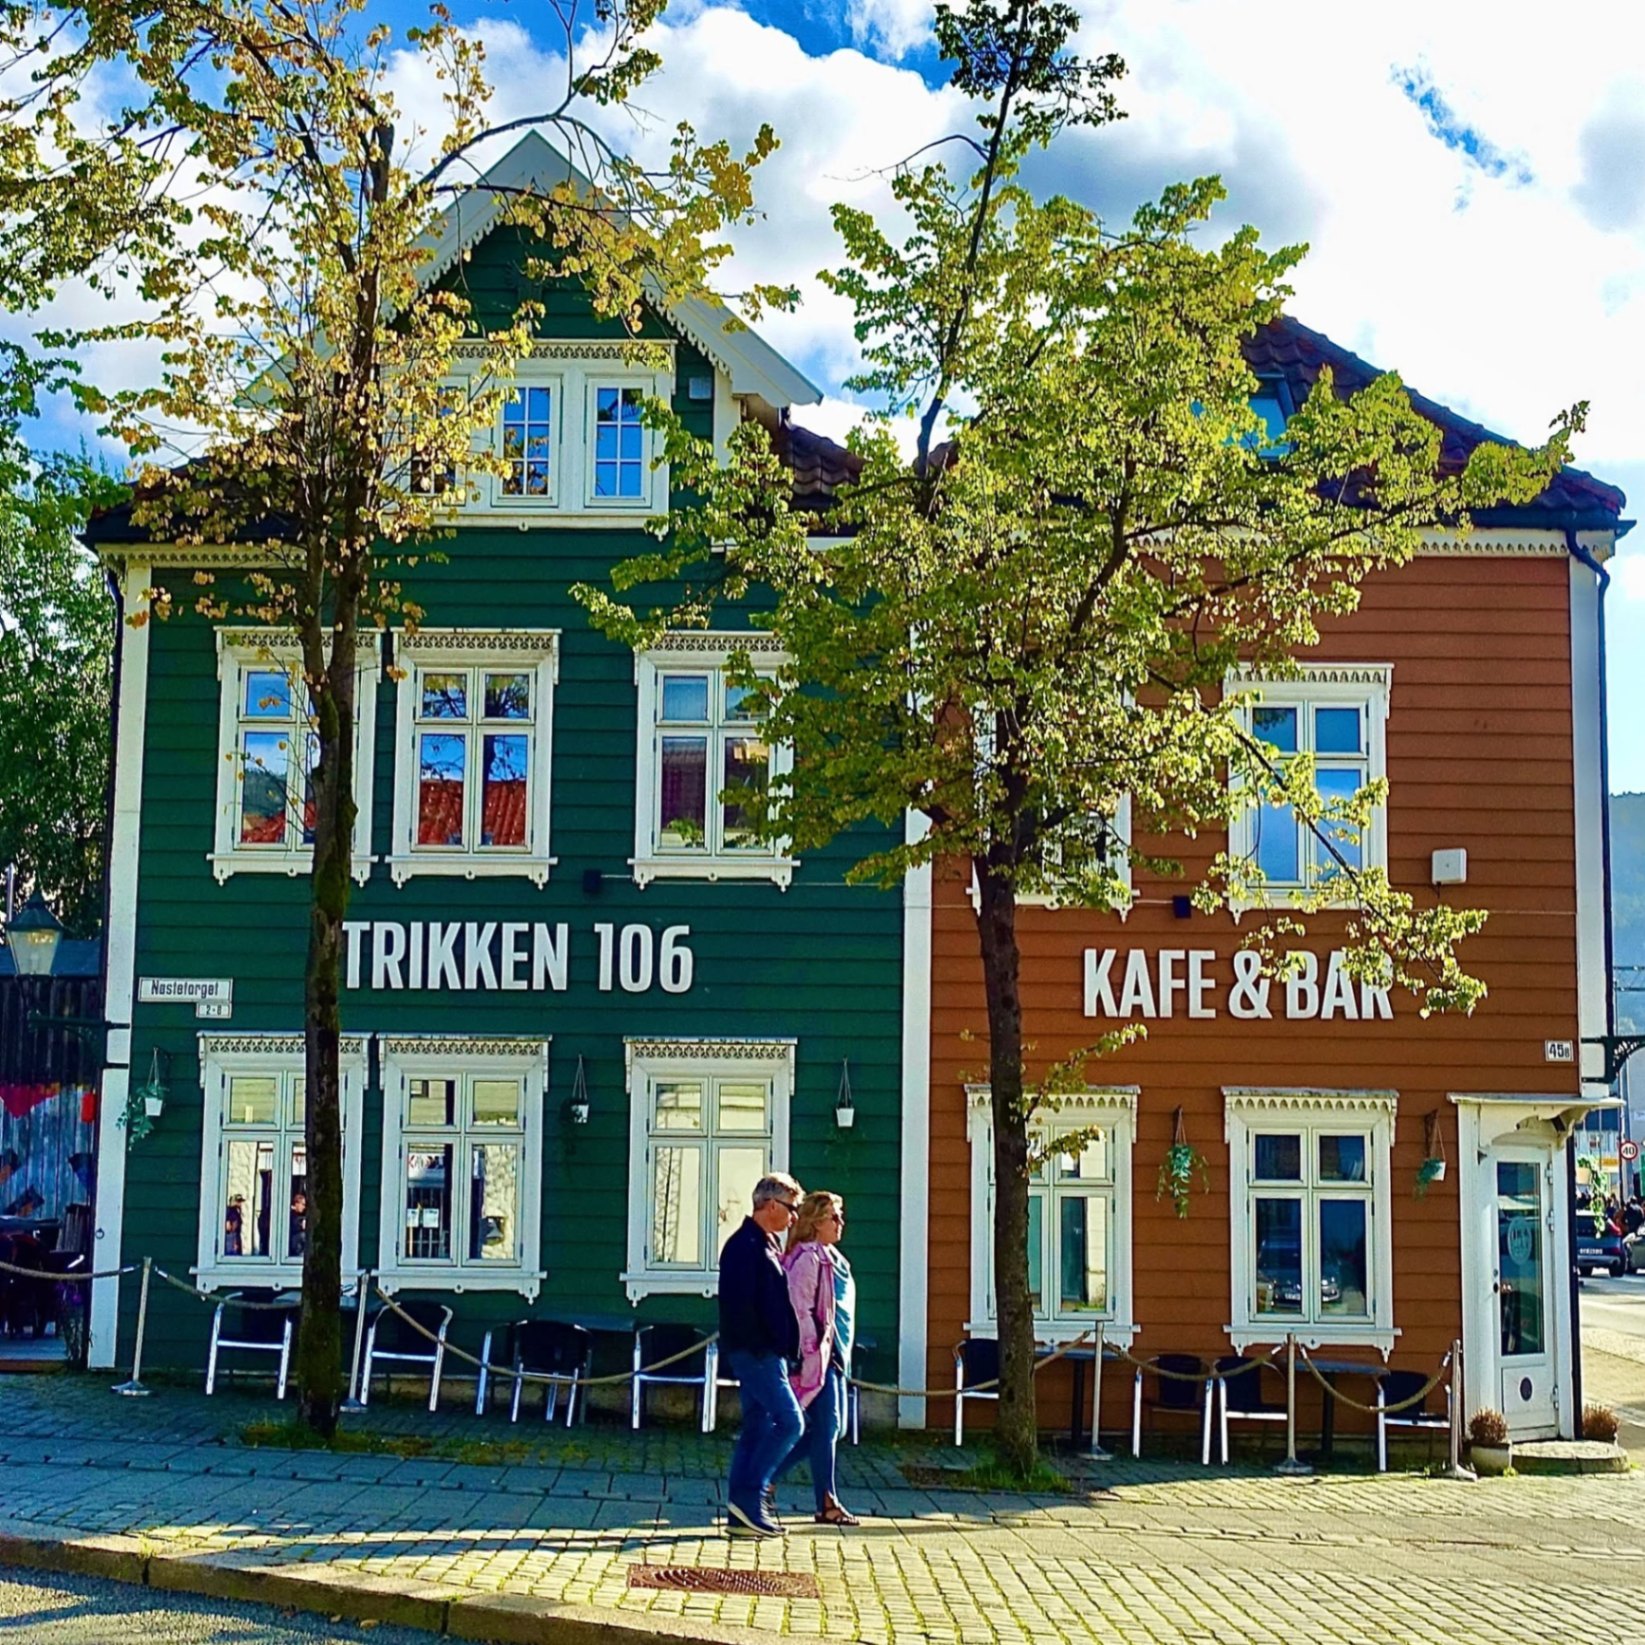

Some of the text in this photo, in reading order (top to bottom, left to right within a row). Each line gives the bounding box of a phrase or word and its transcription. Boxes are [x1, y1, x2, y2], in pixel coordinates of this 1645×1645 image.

[342, 921, 694, 993] TRIKKEN 106
[1083, 948, 1394, 1020] KAFE & BAR
[1622, 1145, 1635, 1156] 40
